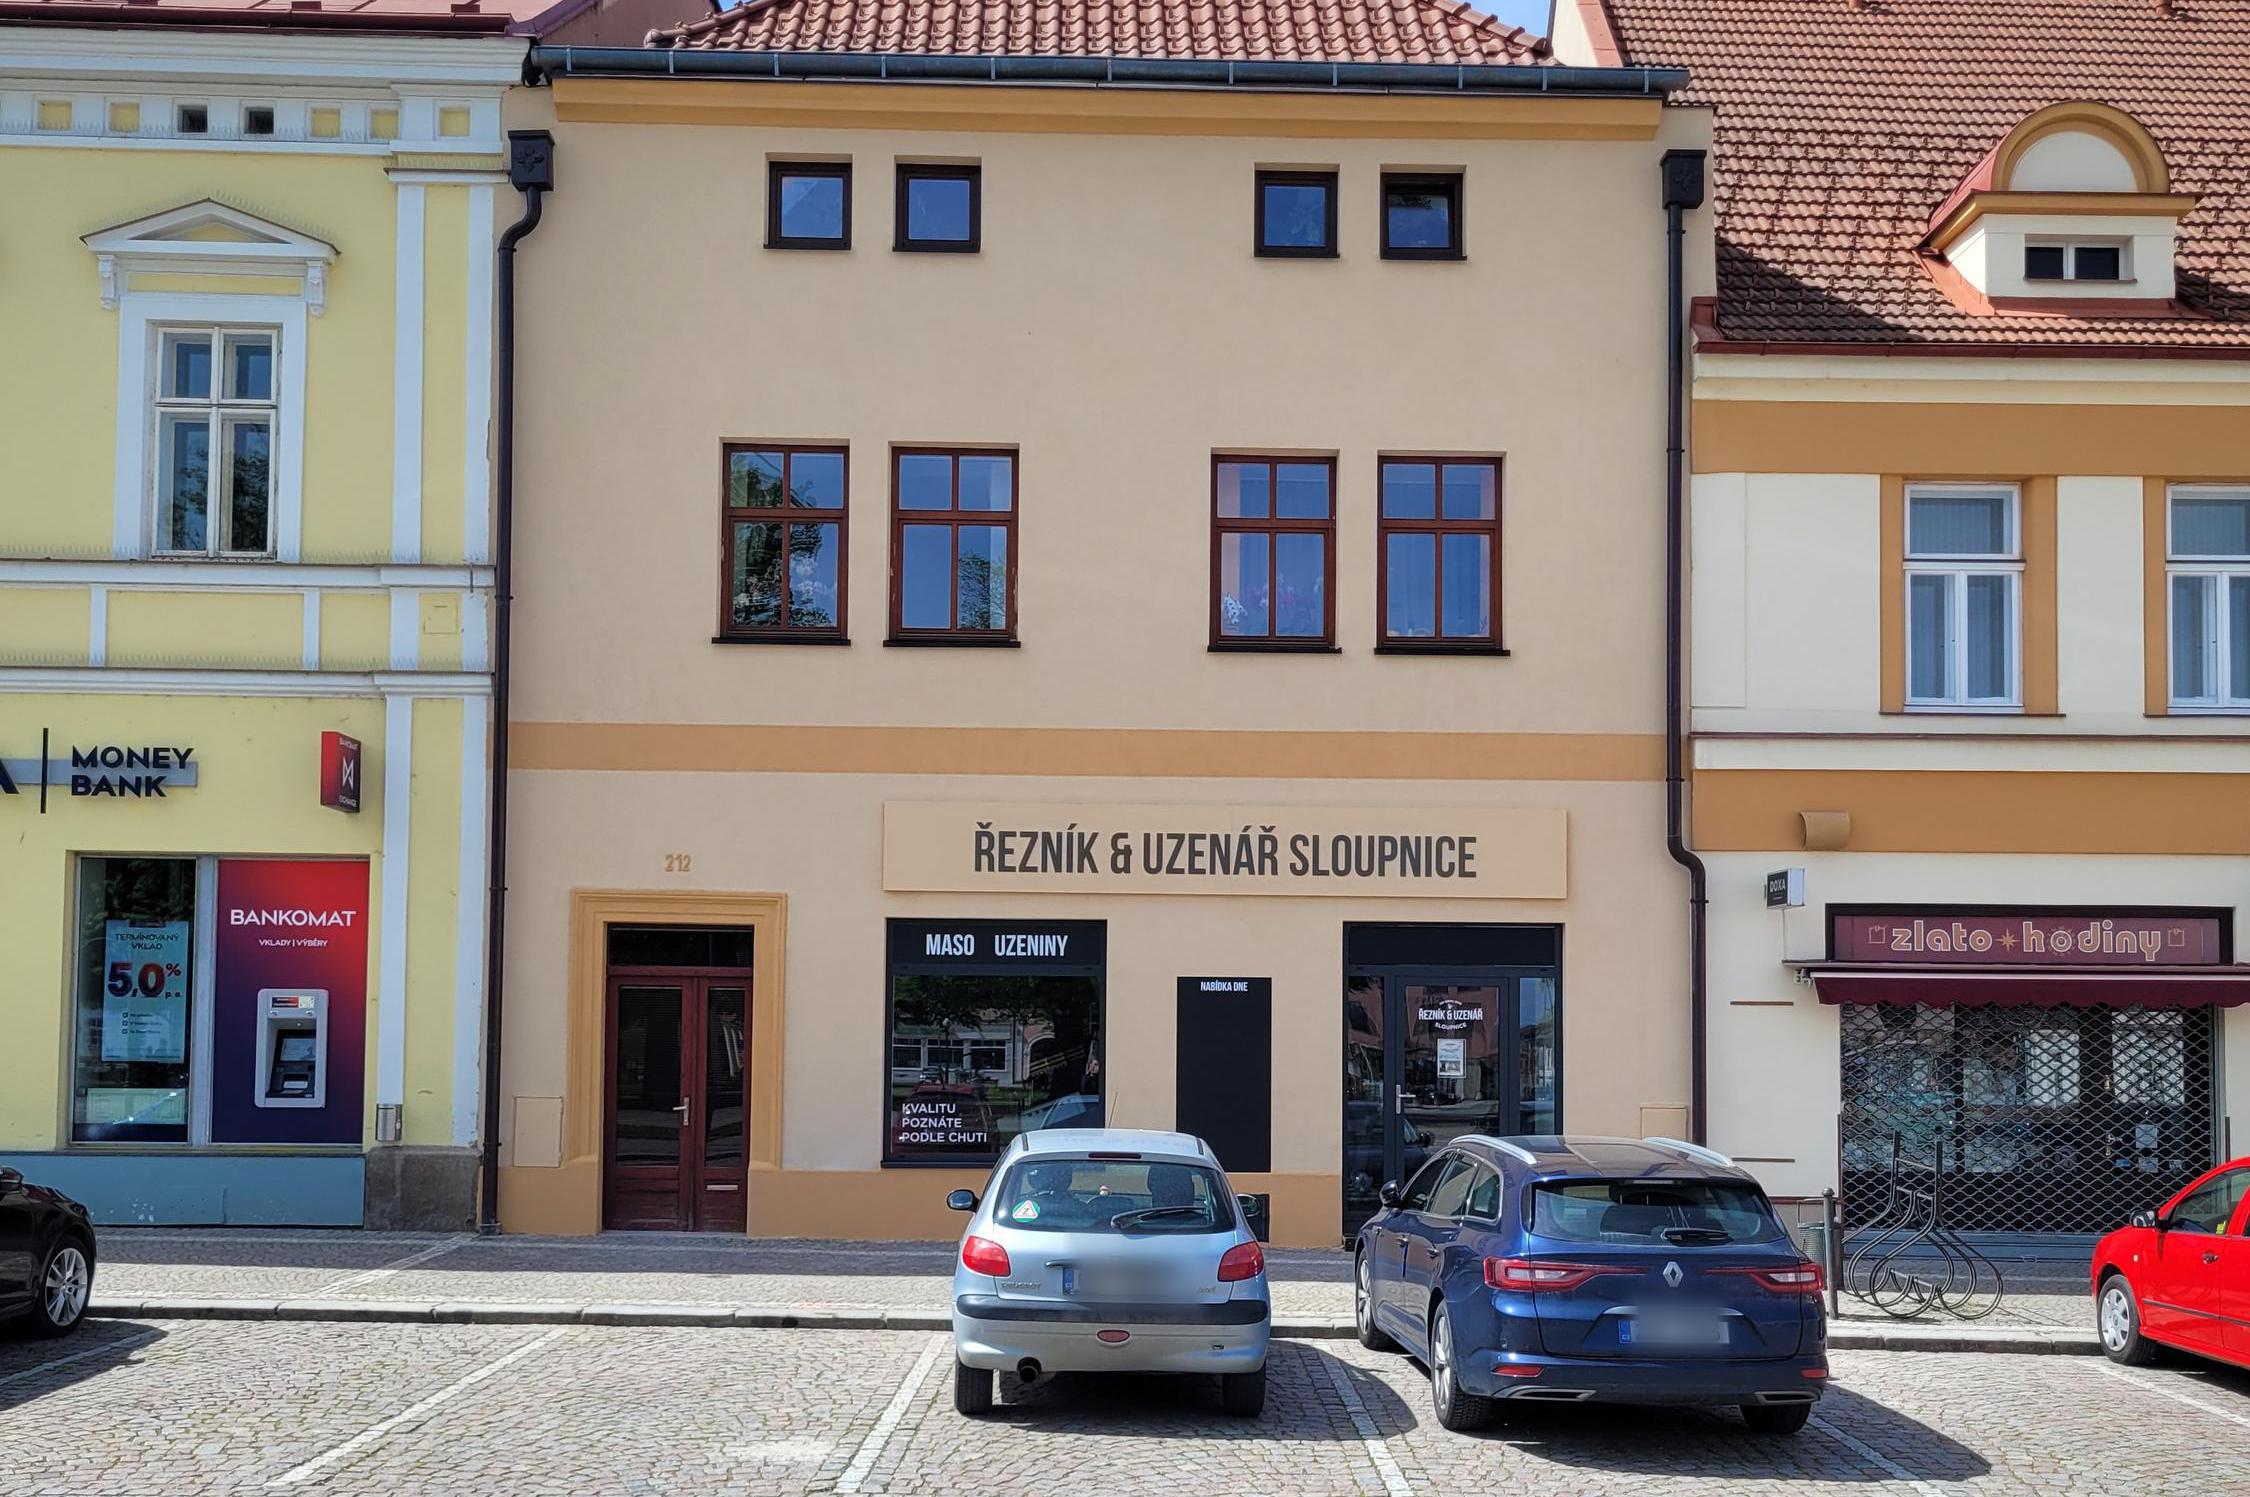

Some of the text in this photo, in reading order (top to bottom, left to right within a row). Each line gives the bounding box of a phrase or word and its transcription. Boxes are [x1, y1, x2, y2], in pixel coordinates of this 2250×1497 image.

[72, 745, 194, 769] MONEY
[71, 775, 167, 798] BANK
[974, 821, 1477, 878] ŘEZNÍK & UZENÁŘ SLOUPNICE
[665, 853, 692, 872] 212
[1769, 879, 1786, 892] DOXA
[230, 909, 357, 927] BANKOMAT
[131, 942, 163, 950] VKLAD
[259, 939, 291, 947] VKLADY
[297, 938, 328, 947] VÝBĚRY
[926, 934, 1068, 956] MASO UZENINY
[1890, 919, 2162, 962] zlato hodiny
[1200, 980, 1249, 992] NABÍDKA DNE
[1418, 1008, 1446, 1020] ŘEZNÍK
[1454, 1008, 1483, 1020] UZENÁŘ
[1434, 1021, 1467, 1031] SLOUPNICE
[902, 1103, 956, 1114] KVALITU
[902, 1115, 962, 1128] POZNÁTE
[902, 1132, 987, 1143] PODLE CHUTI
